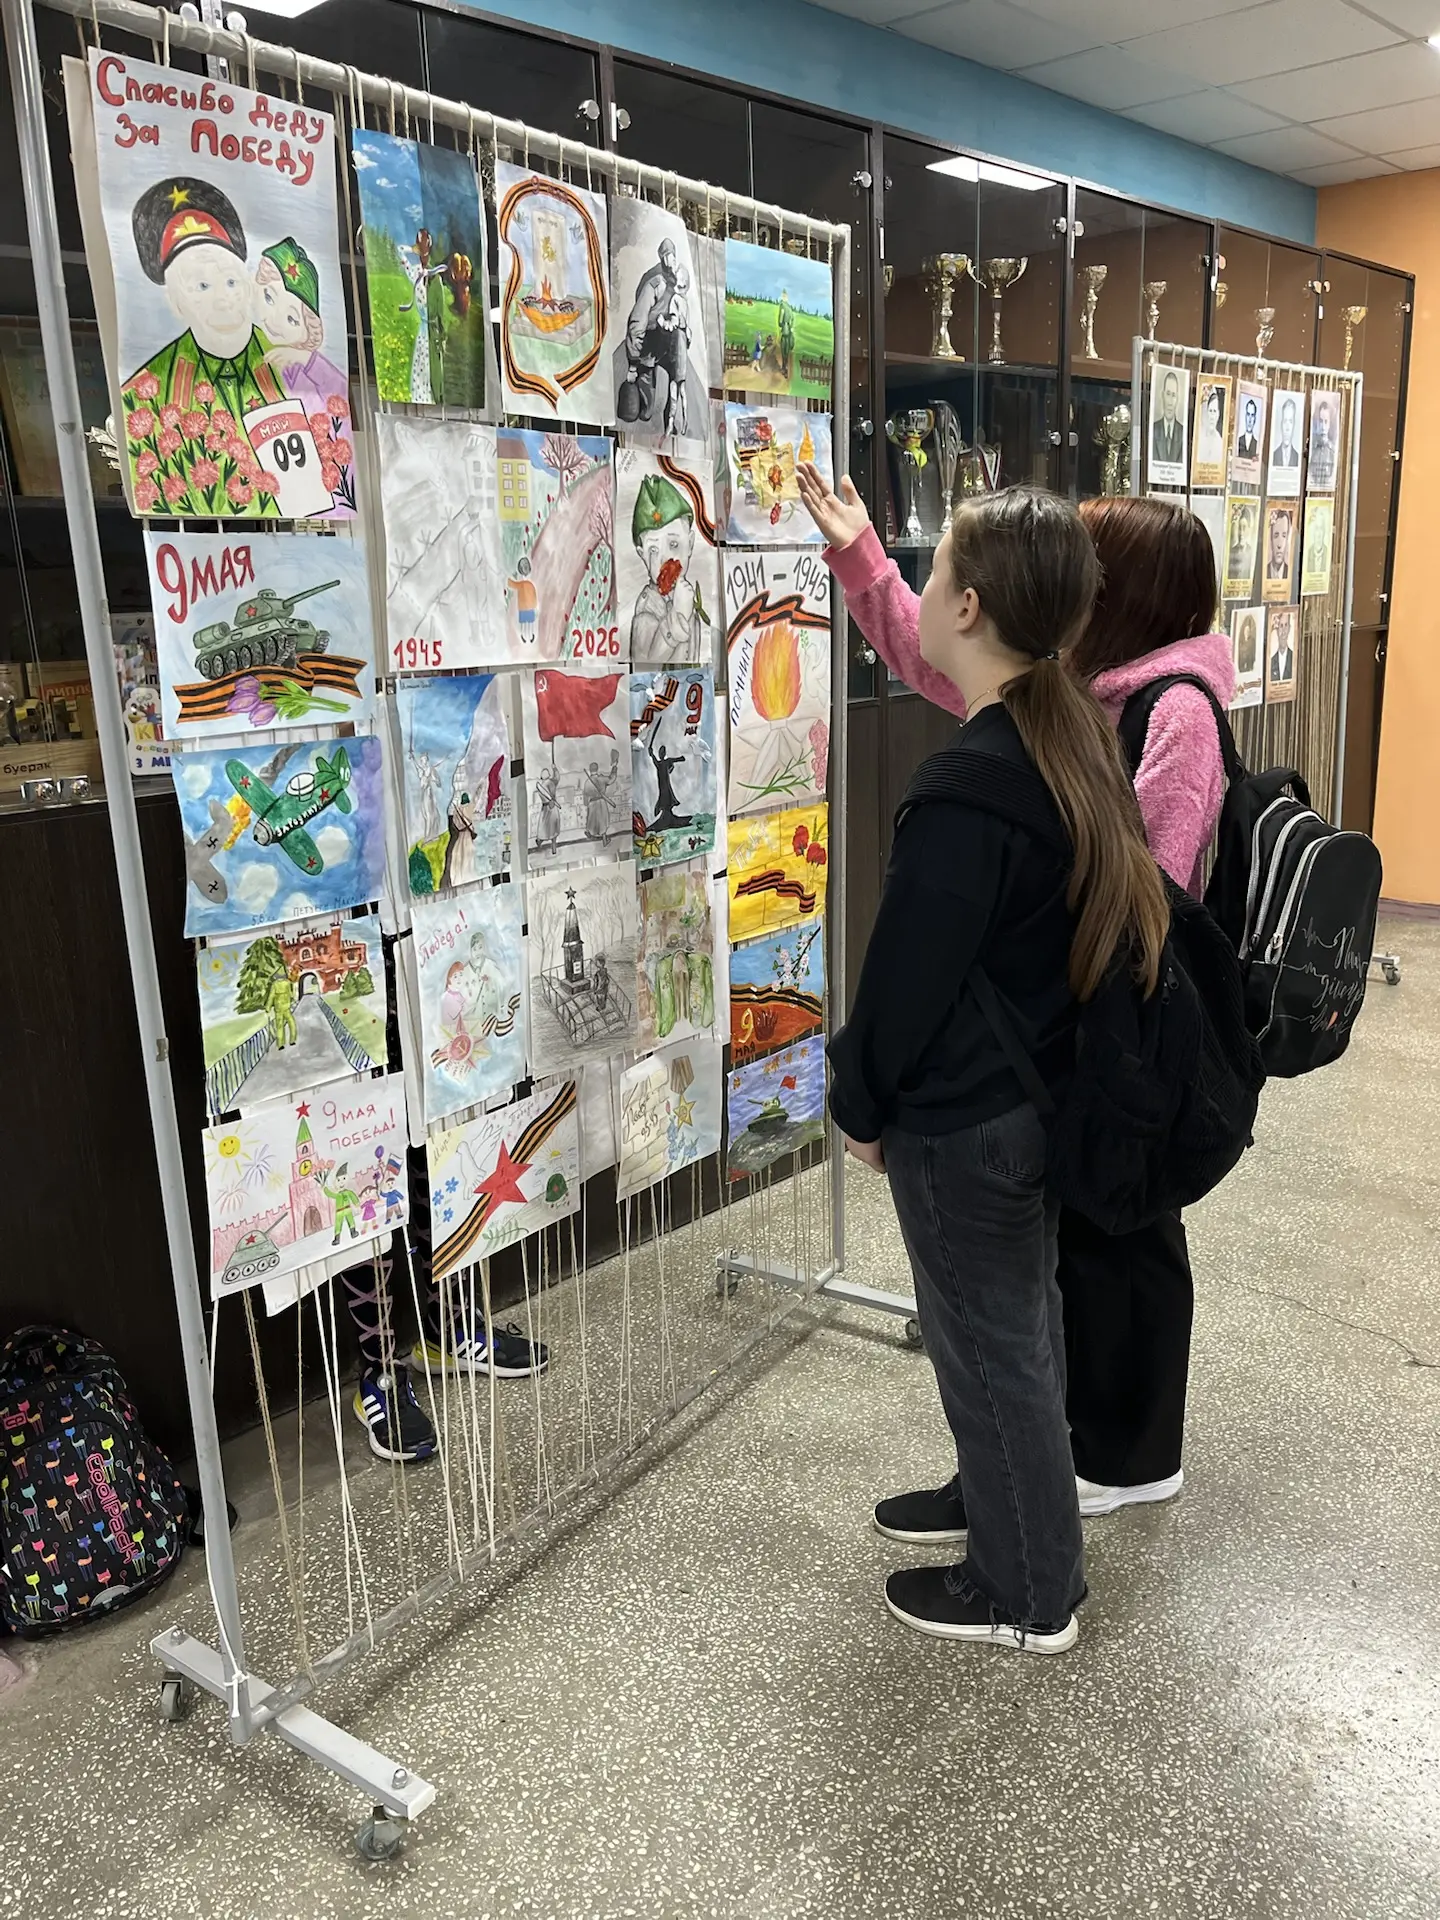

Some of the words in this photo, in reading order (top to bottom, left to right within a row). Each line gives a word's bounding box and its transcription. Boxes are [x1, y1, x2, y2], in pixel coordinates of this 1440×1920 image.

[97, 56, 234, 114] Спасибо
[249, 95, 324, 144] Деду
[115, 113, 159, 148] За
[191, 119, 314, 186] Победу
[259, 414, 290, 440] МАЙ
[273, 433, 306, 472] 09
[156, 543, 188, 623] 9
[191, 545, 255, 604] МАЯ
[727, 555, 766, 610] 1941
[793, 556, 829, 602] 1945
[394, 639, 442, 668] 1945
[572, 627, 620, 658] 2026
[686, 683, 703, 723] 9
[731, 638, 753, 727] ПОМНИМ
[3, 762, 52, 775] буерак
[419, 909, 468, 969] Победа!
[738, 1008, 754, 1043] 9
[322, 1101, 337, 1129] 9
[341, 1104, 377, 1124] МАЯ
[329, 1108, 396, 1152] ПОБЕДА!
[85, 1452, 140, 1565] CoolPack
